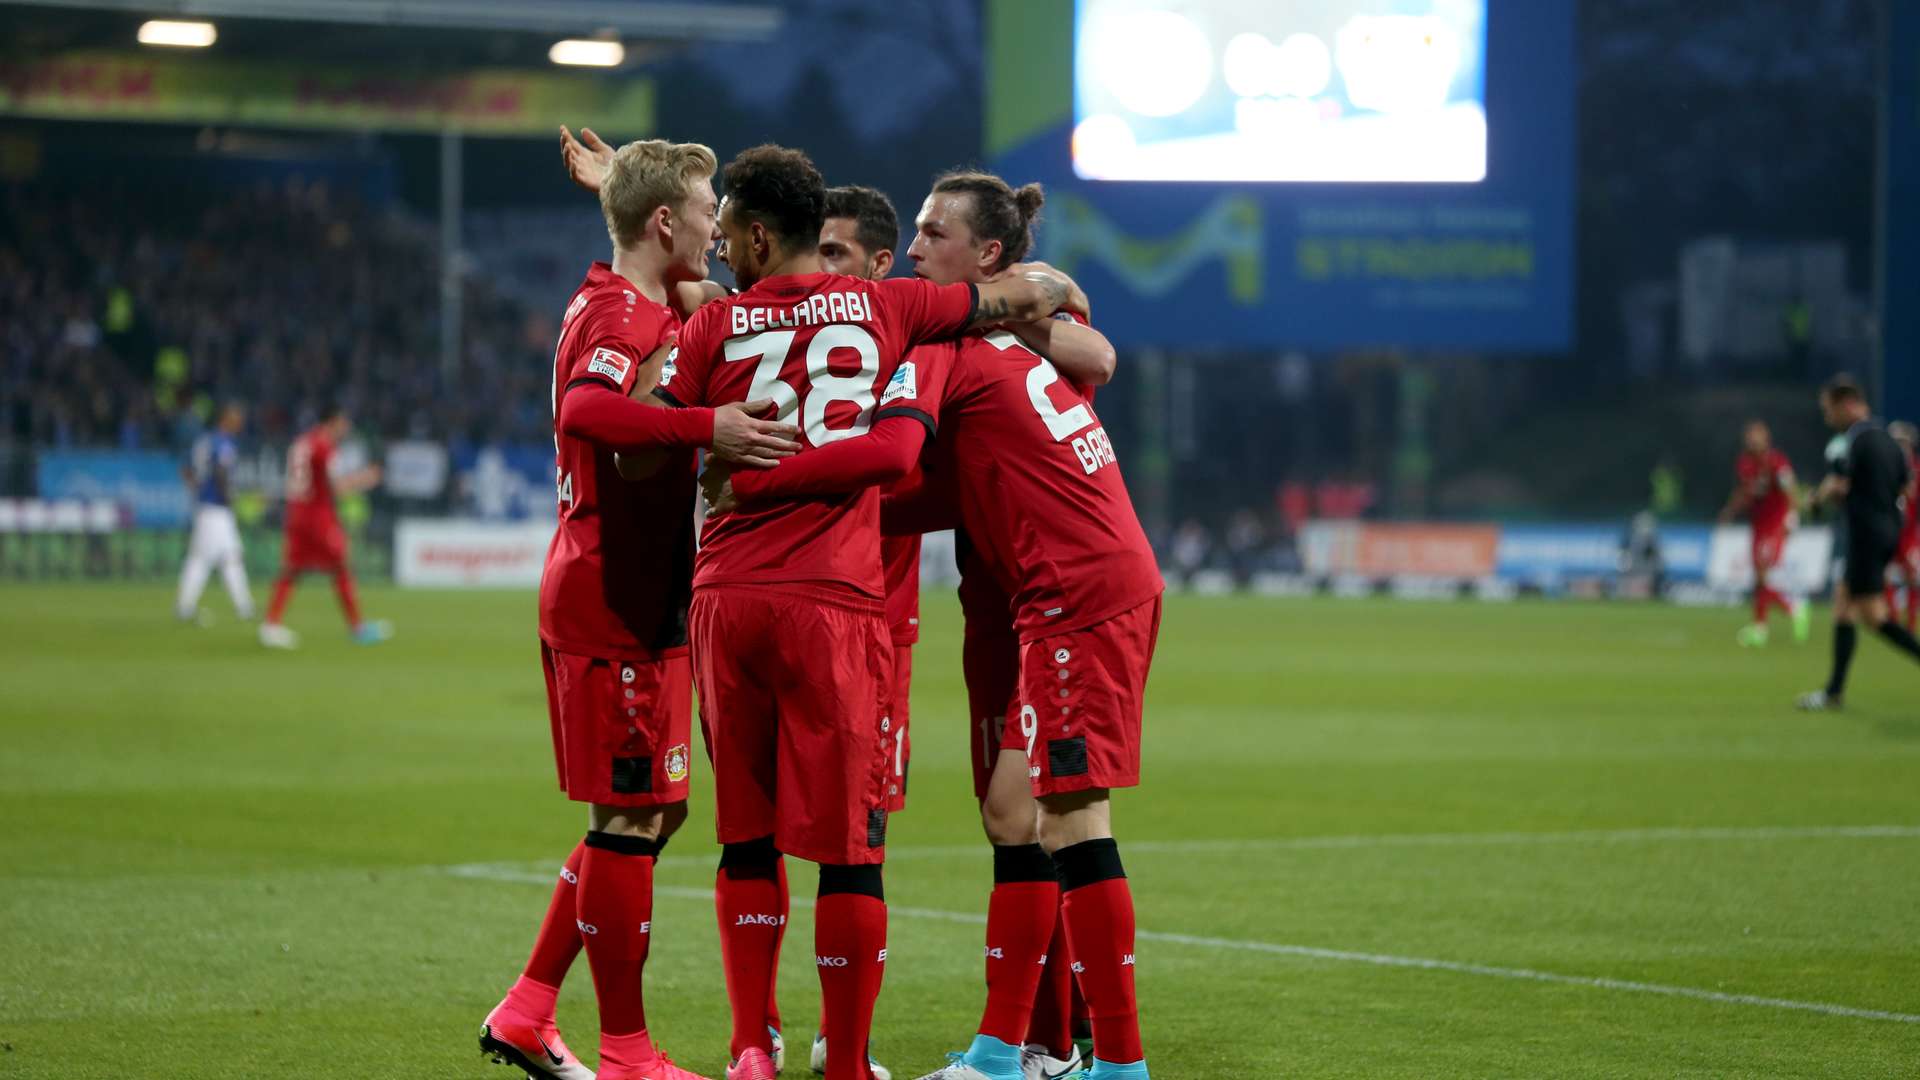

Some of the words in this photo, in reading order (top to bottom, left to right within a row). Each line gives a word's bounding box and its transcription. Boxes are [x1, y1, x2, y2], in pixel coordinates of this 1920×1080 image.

[732, 291, 872, 334] BELLARABI
[724, 324, 880, 448] 38
[736, 914, 777, 926] JAKO
